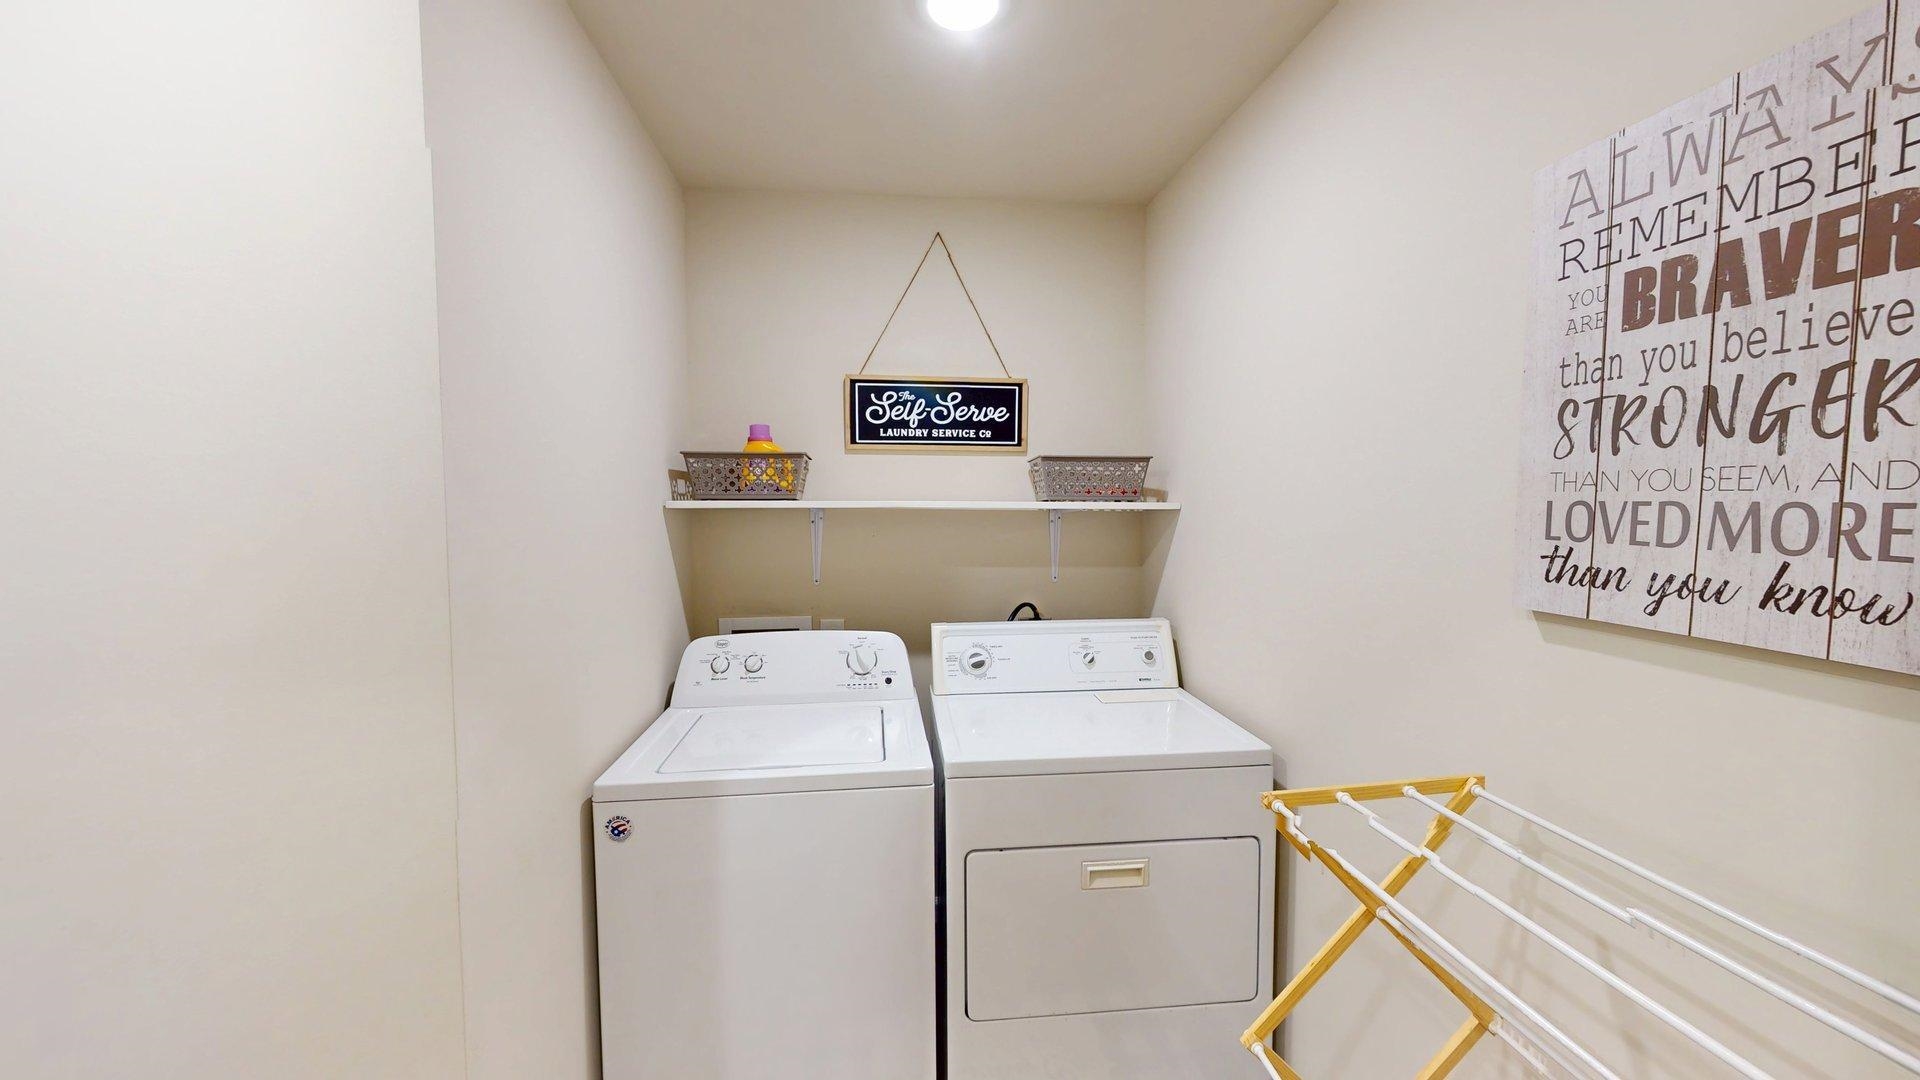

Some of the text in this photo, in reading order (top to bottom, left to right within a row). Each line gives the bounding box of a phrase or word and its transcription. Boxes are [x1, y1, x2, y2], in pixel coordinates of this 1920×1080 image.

[1621, 187, 1920, 333] BRAVER
[1568, 283, 1609, 311] YOU
[1565, 311, 1607, 336] ARE
[1559, 298, 1915, 388] than you believe
[865, 391, 1010, 428] Self-Serve
[898, 390, 916, 402] The
[1553, 358, 1920, 460] STRONGER
[879, 428, 929, 437] LAUNDRY
[931, 429, 976, 438] SERVICE
[1550, 460, 1920, 494] THAN YOU SEEM, AND
[1544, 500, 1918, 564] LOVED MORE
[1540, 544, 1914, 627] than you know
